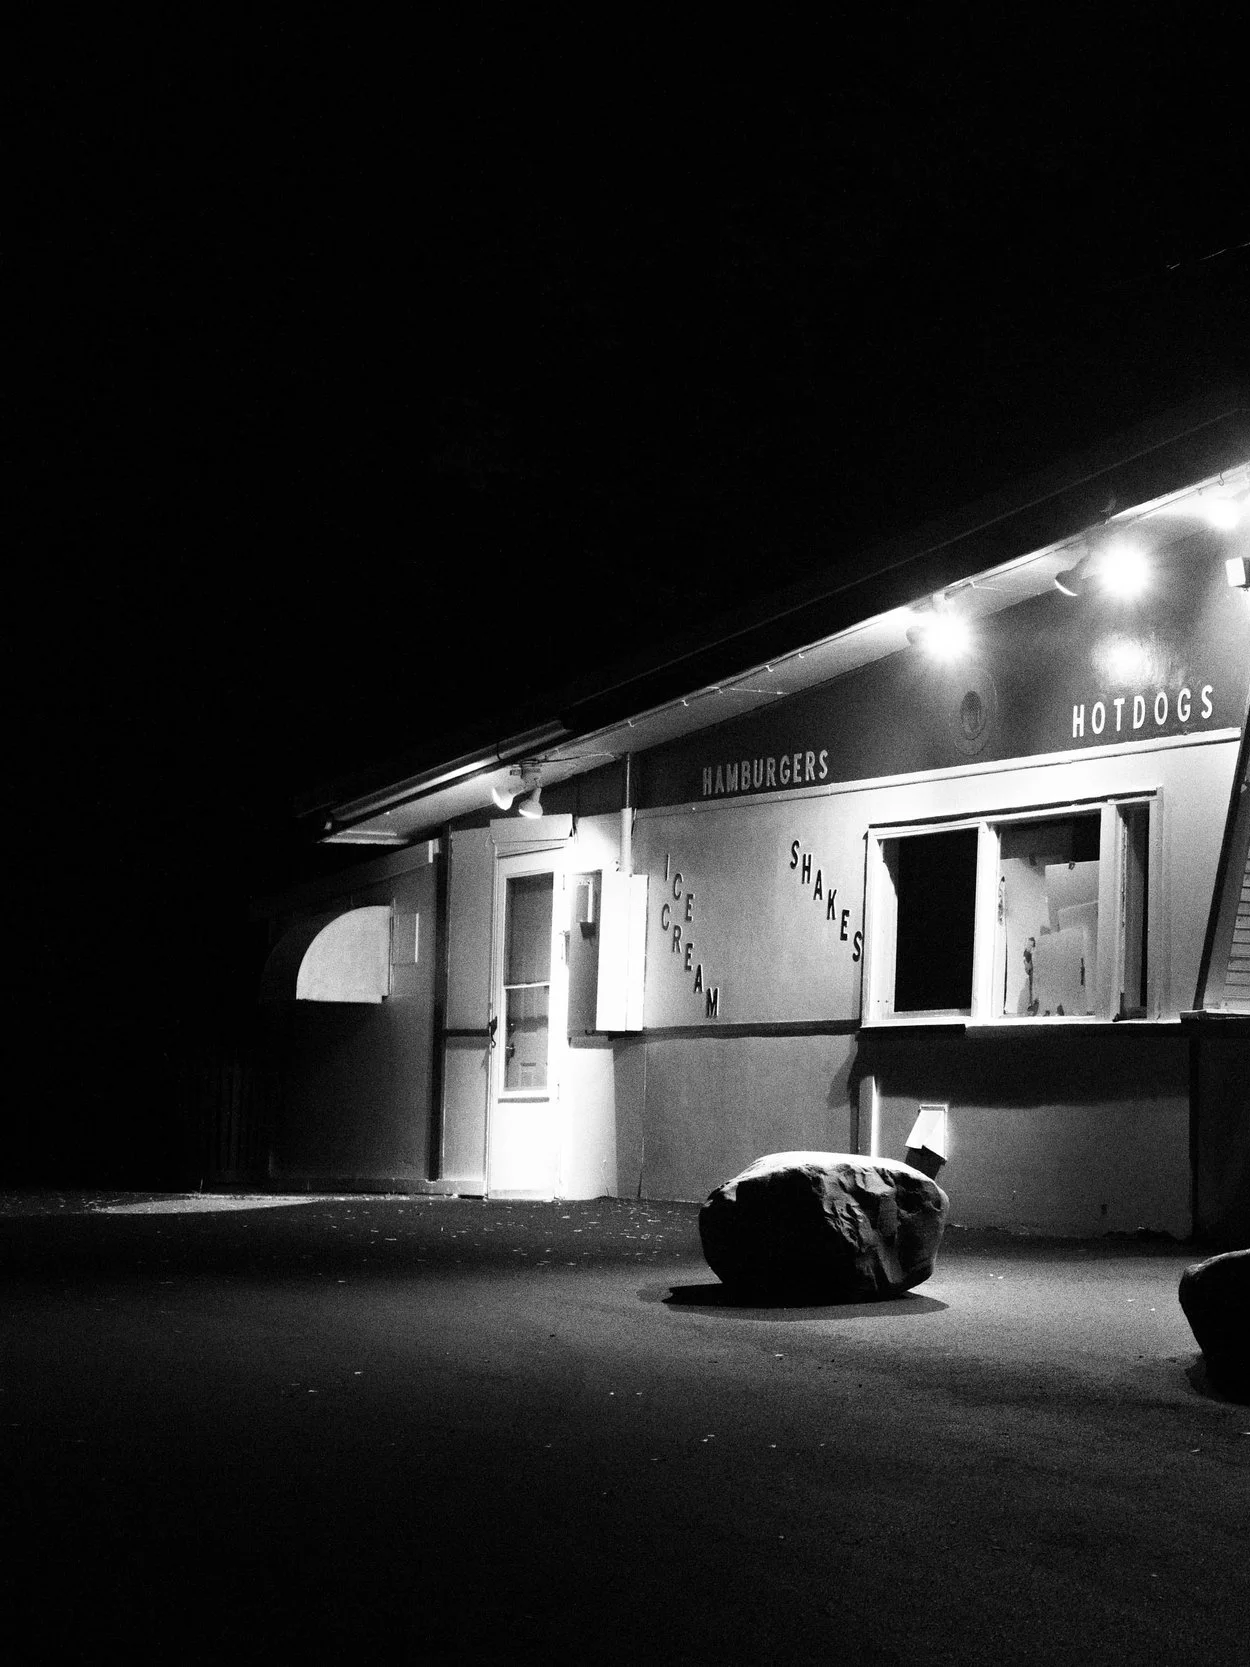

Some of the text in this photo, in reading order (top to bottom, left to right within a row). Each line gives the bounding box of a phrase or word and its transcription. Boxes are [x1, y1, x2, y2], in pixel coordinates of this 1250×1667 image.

[1072, 684, 1214, 738] HOTDOGS
[701, 748, 830, 797] HAMBURGERS
[665, 853, 696, 922] ICE
[789, 839, 864, 963] SHAKES
[660, 903, 721, 1018] CREAM
